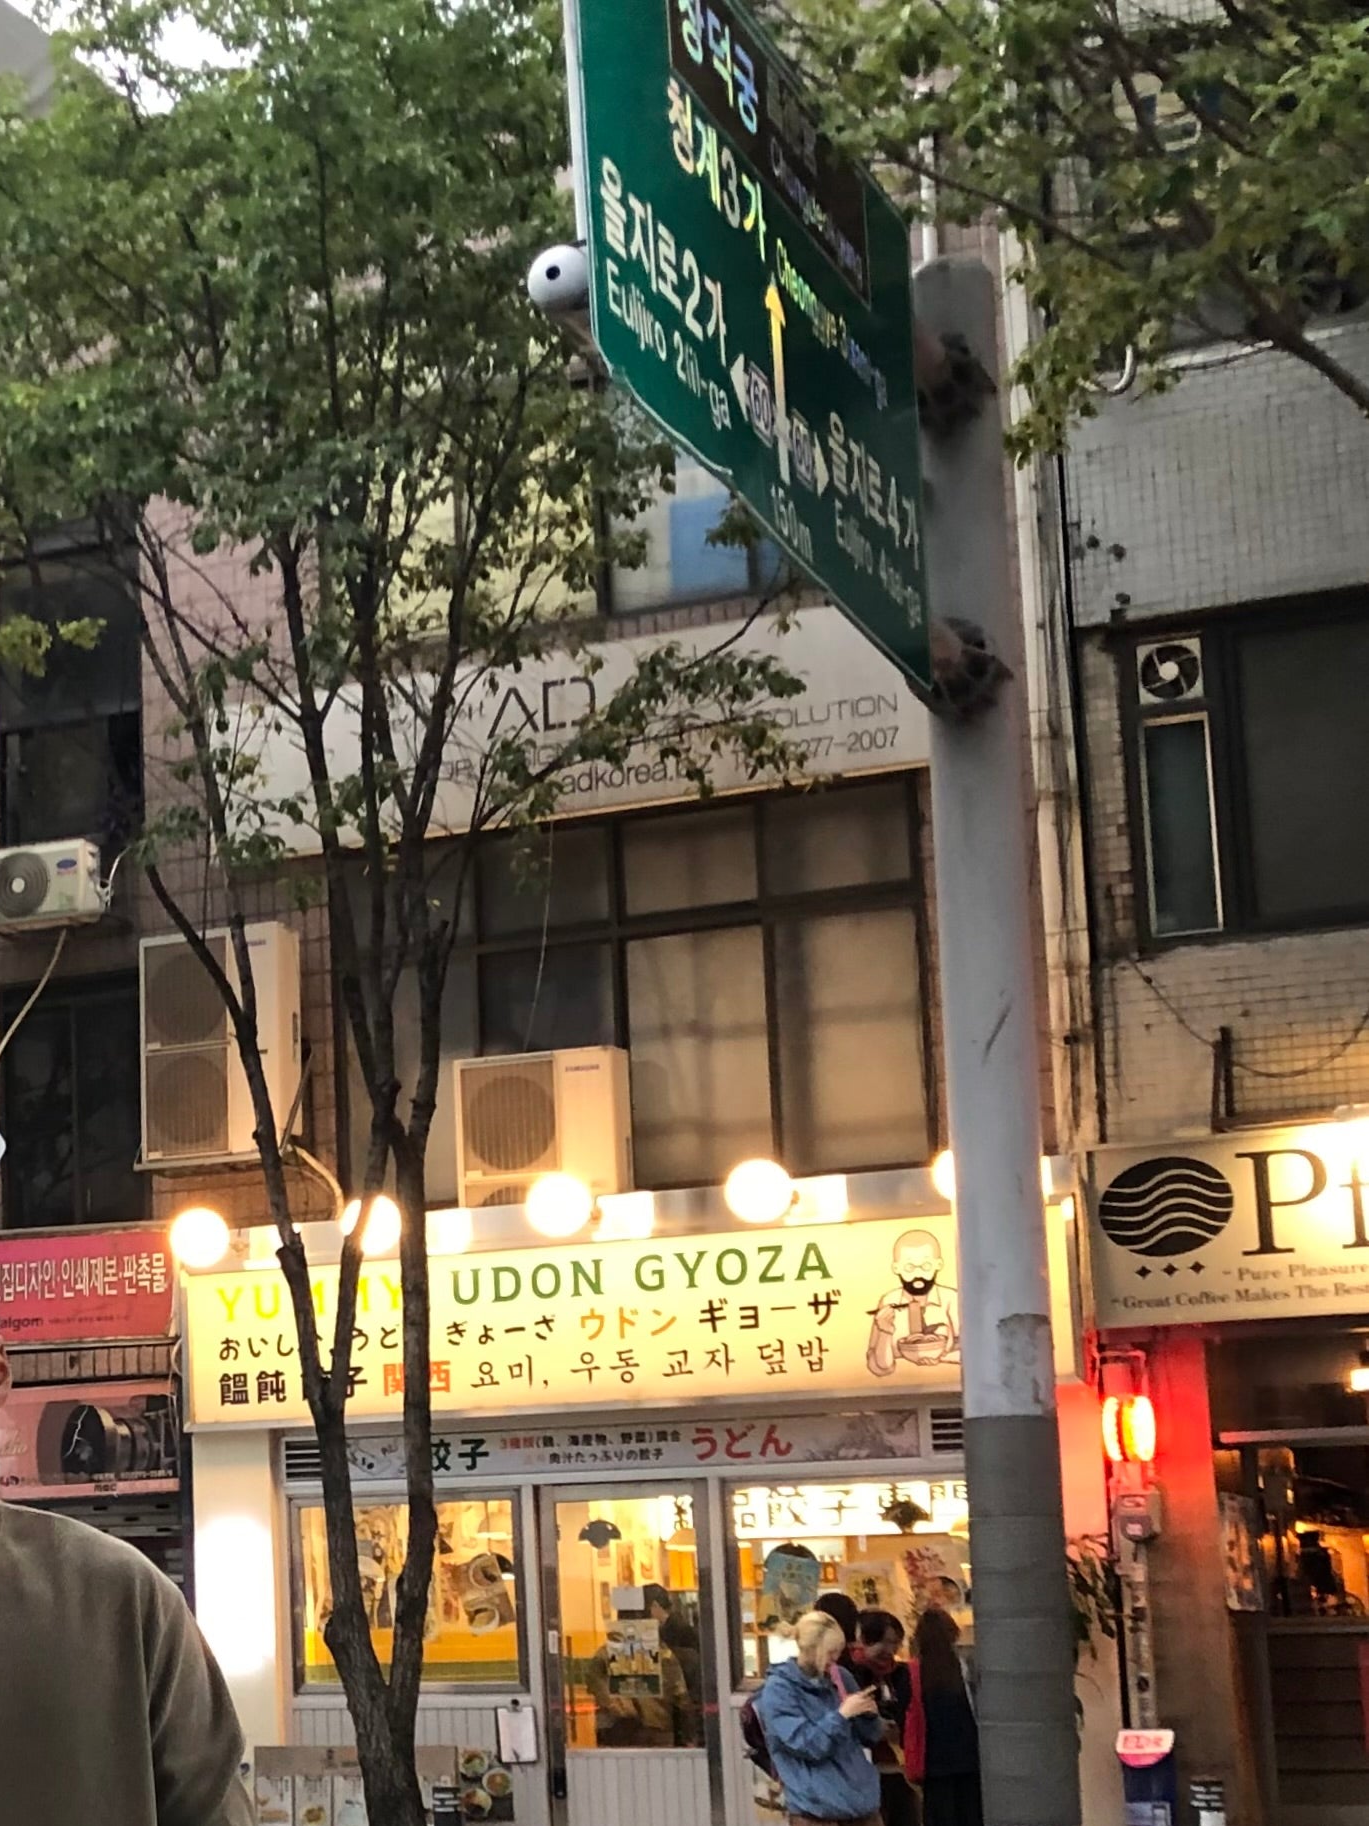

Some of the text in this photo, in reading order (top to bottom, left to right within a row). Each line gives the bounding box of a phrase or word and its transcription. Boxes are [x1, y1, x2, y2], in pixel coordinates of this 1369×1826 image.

[600, 156, 727, 368] 을지로2가
[606, 257, 668, 363] Euljiro
[828, 411, 920, 571] 을지로4가
[764, 693, 898, 729] OLUTION
[450, 1258, 605, 1306] UDON
[634, 1241, 834, 1292] GYOZA
[1175, 1290, 1230, 1307] Coffee
[1234, 1287, 1291, 1303] Makes
[1295, 1284, 1330, 1299] The
[1237, 1262, 1369, 1282] Pure Pleasure
[218, 1332, 323, 1361] おいし
[579, 1306, 678, 1341] ウドン
[698, 1288, 842, 1334] ギョーザ
[570, 1347, 641, 1385] 우동
[661, 1341, 736, 1379] 교자
[756, 1335, 830, 1378] 덮밥
[689, 1423, 794, 1463] うどん
